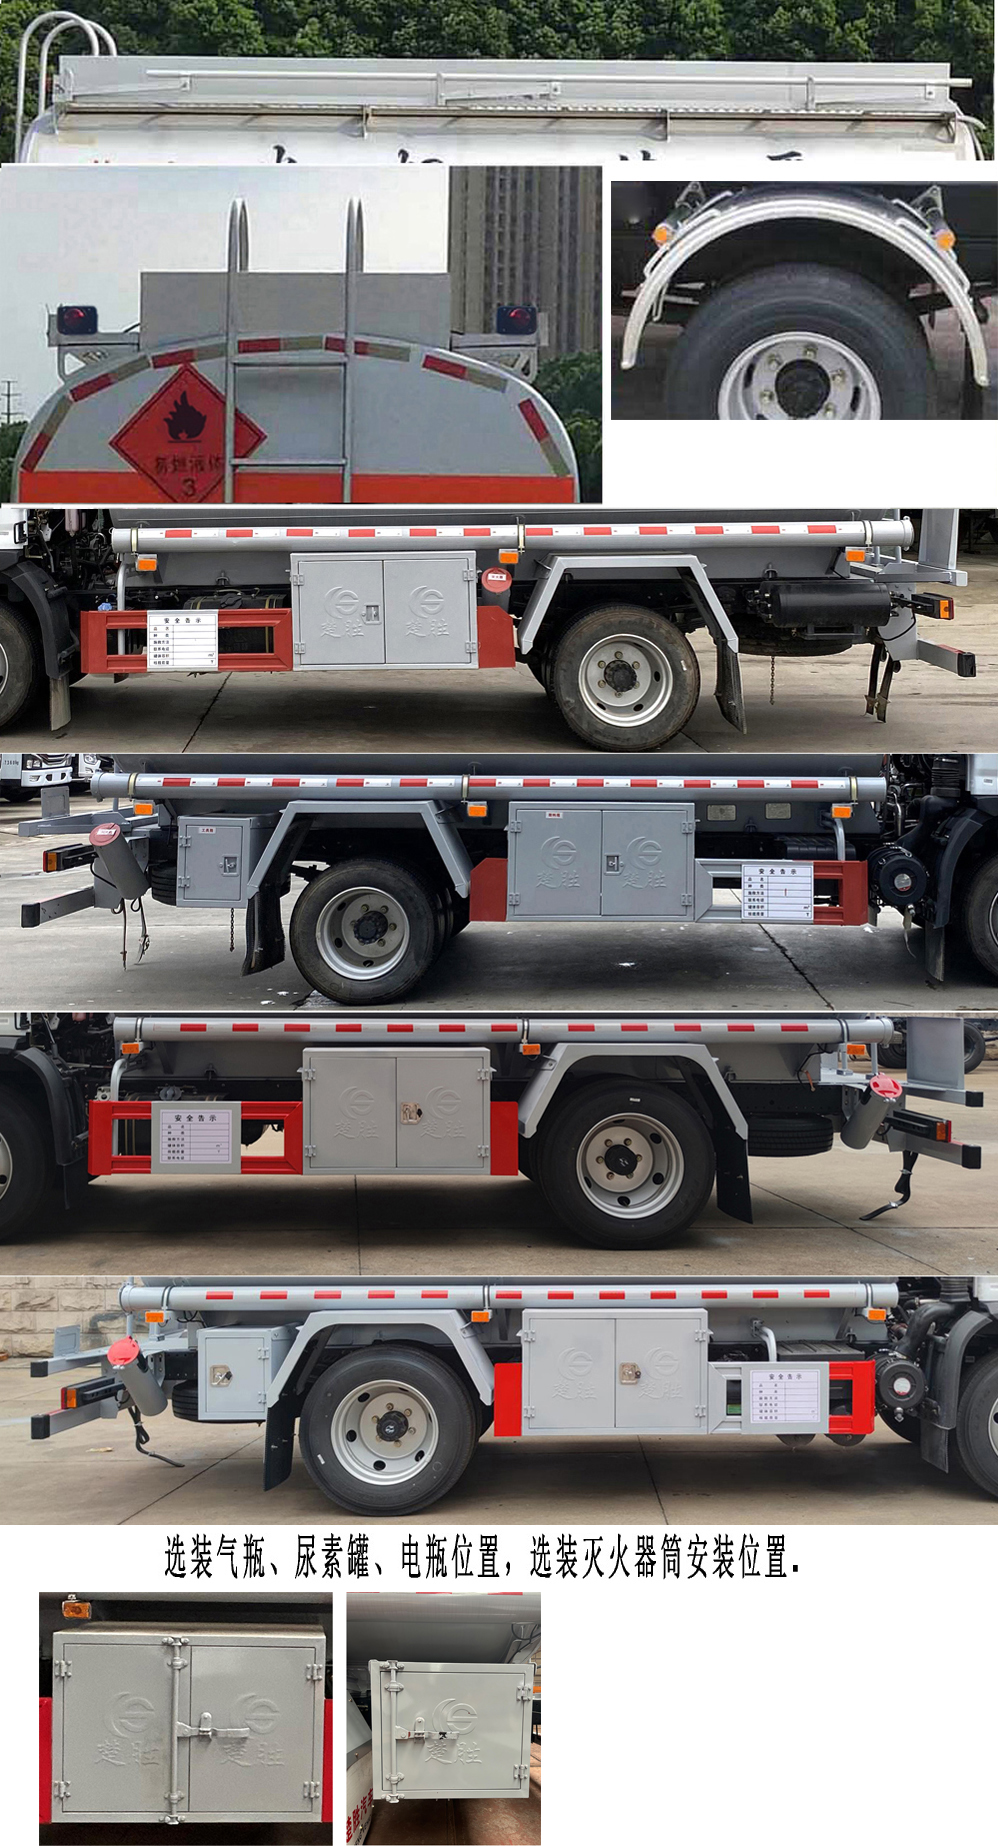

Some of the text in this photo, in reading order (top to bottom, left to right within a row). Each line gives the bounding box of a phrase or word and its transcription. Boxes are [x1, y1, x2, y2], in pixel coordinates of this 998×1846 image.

[182, 477, 197, 498] 3
[164, 617, 202, 625] 安全告示
[174, 1114, 217, 1122] 安全告示
